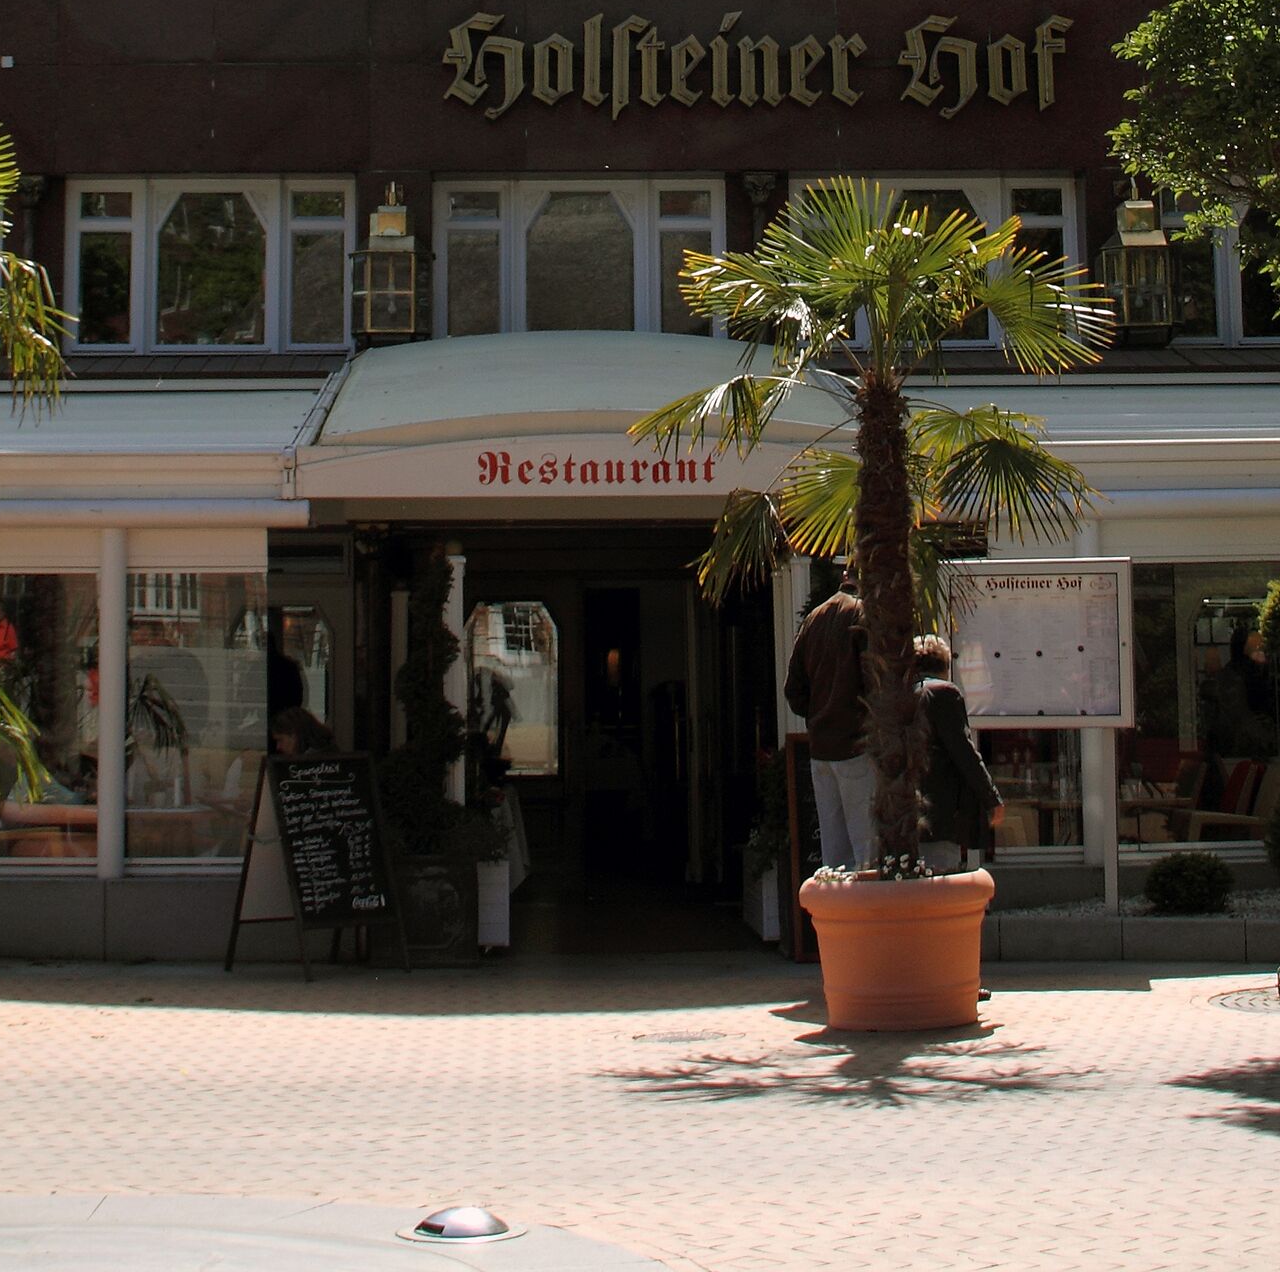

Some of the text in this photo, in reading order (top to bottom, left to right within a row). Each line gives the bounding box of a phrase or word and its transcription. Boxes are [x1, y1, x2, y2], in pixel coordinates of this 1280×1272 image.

[898, 14, 1075, 120] Hof
[477, 451, 716, 486] Restaurant
[1056, 576, 1083, 591] Hof
